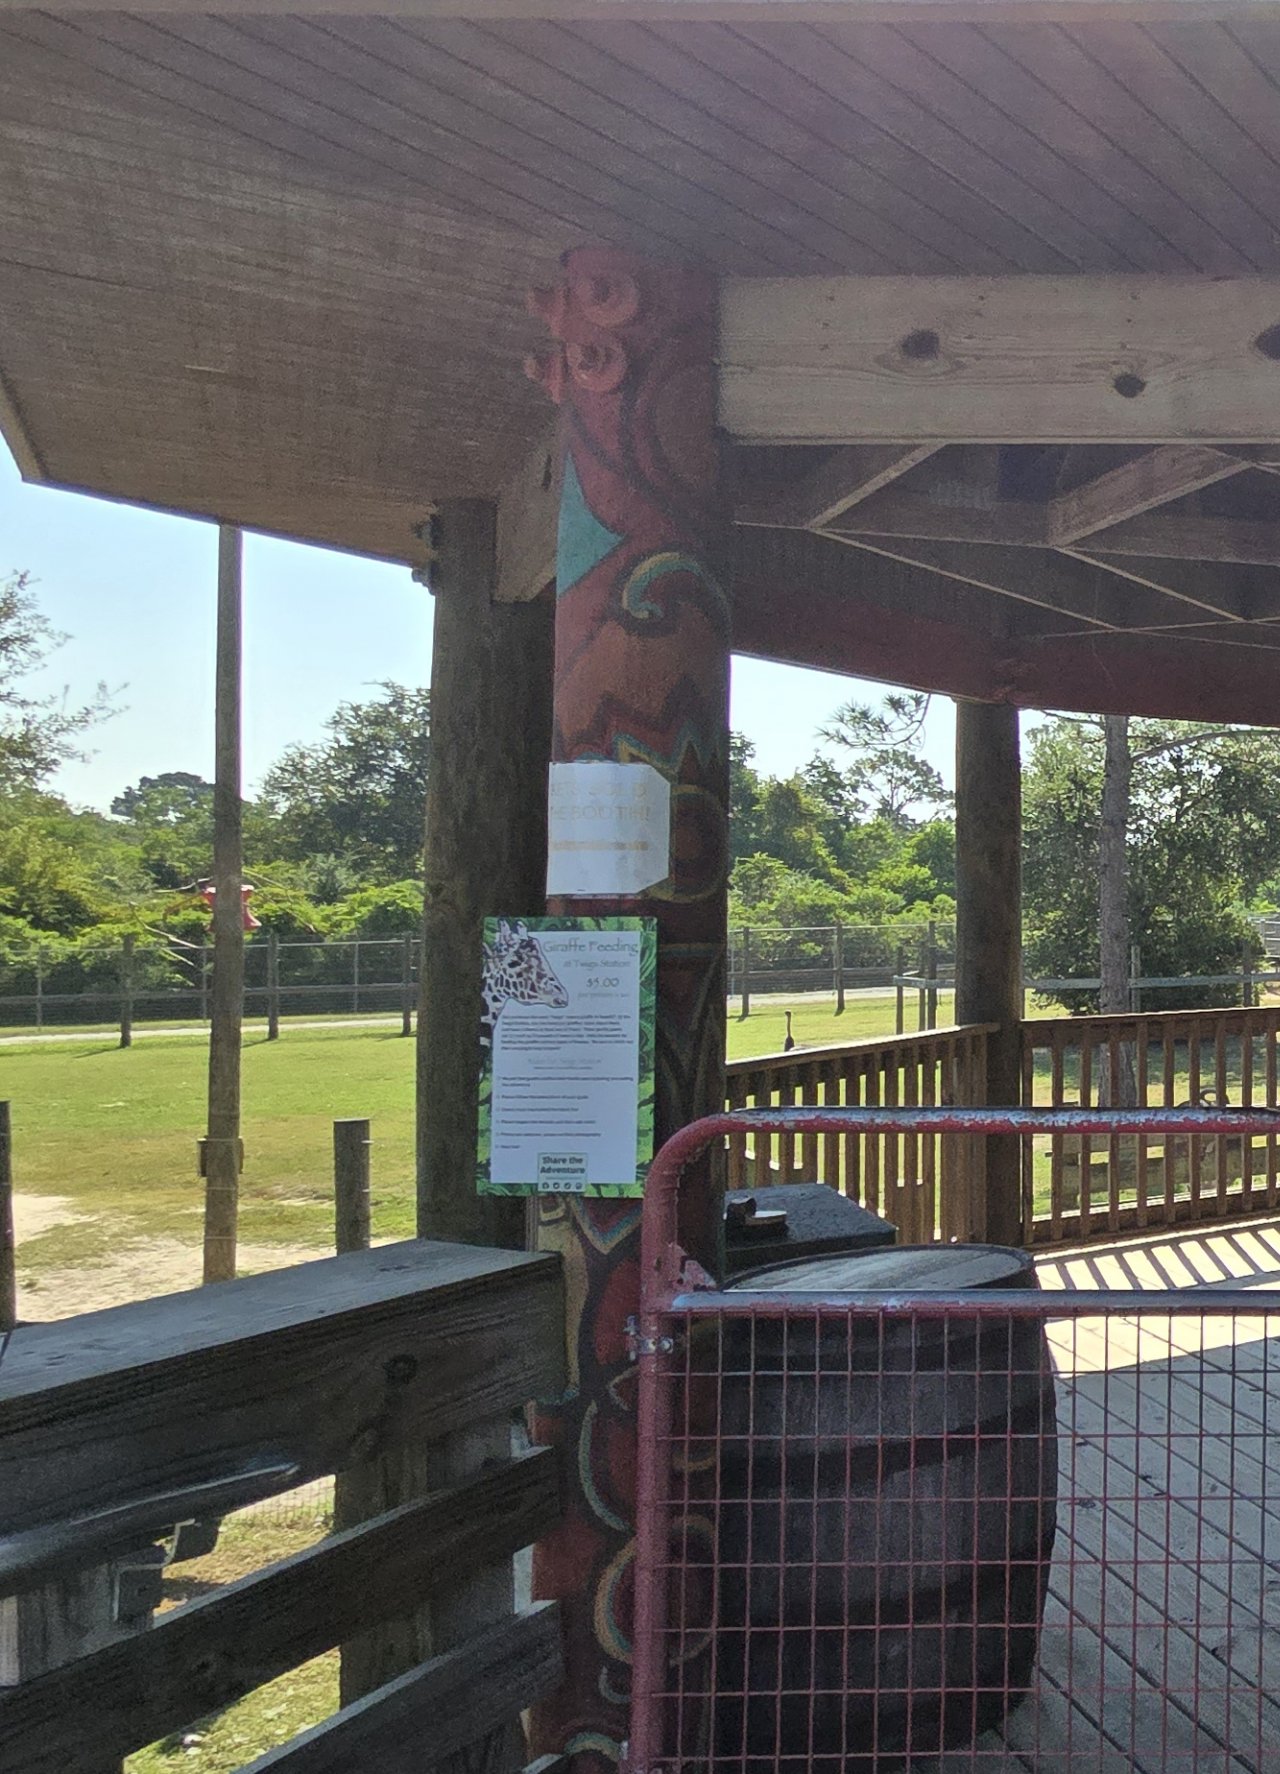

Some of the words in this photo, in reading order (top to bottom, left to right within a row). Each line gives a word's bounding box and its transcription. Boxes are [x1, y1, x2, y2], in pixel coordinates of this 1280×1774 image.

[543, 937, 586, 952] Giraffe
[588, 937, 639, 957] Feeding
[586, 977, 620, 988] $5.00
[541, 1155, 568, 1165] Share
[569, 1156, 584, 1165] the
[540, 1165, 586, 1175] Adventure
